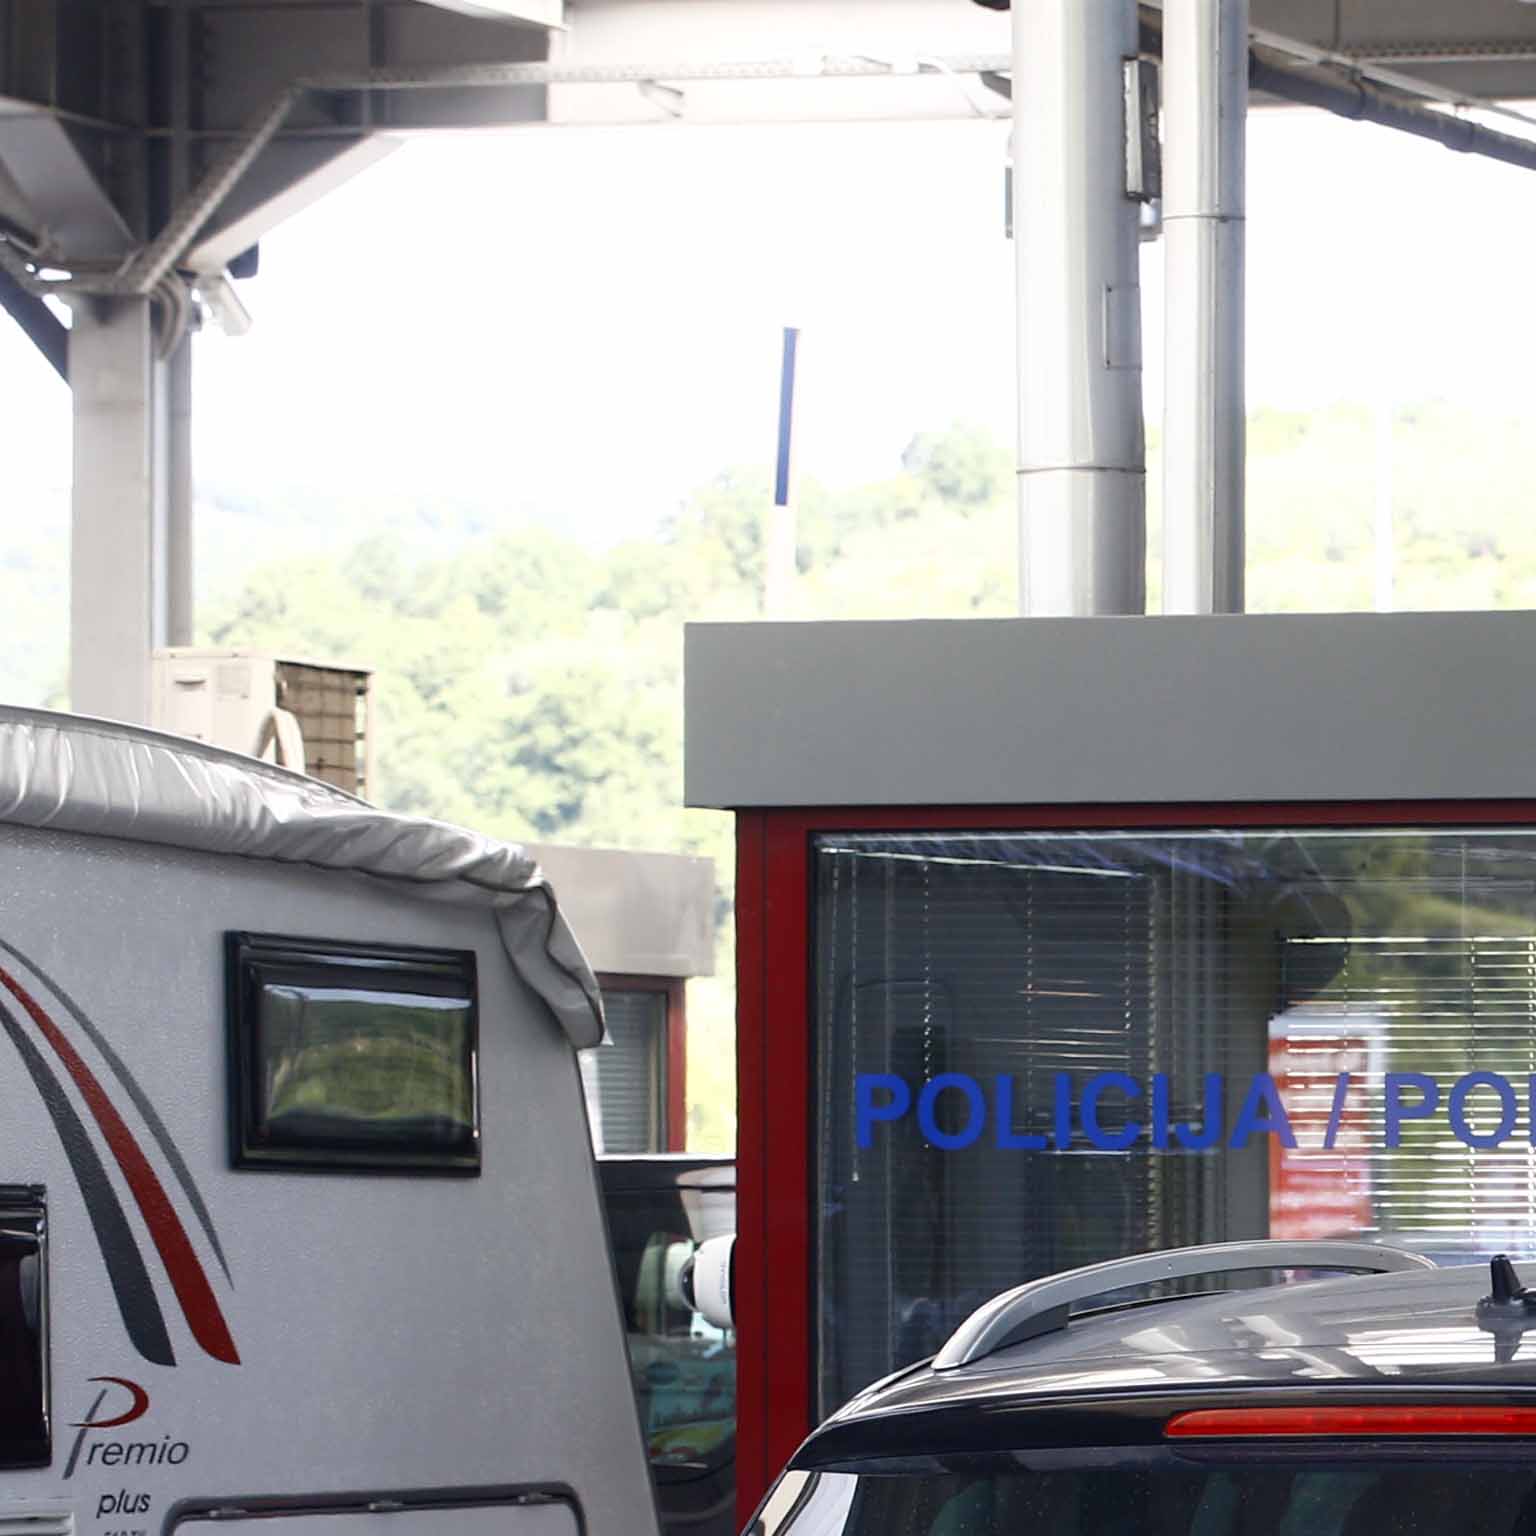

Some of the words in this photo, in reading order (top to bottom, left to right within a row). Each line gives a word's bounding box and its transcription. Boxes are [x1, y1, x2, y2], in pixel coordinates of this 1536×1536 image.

[855, 1072, 1298, 1150] POLICIJA
[1323, 1072, 1351, 1149] /
[62, 1376, 190, 1480] Premio
[96, 1488, 151, 1519] plus
